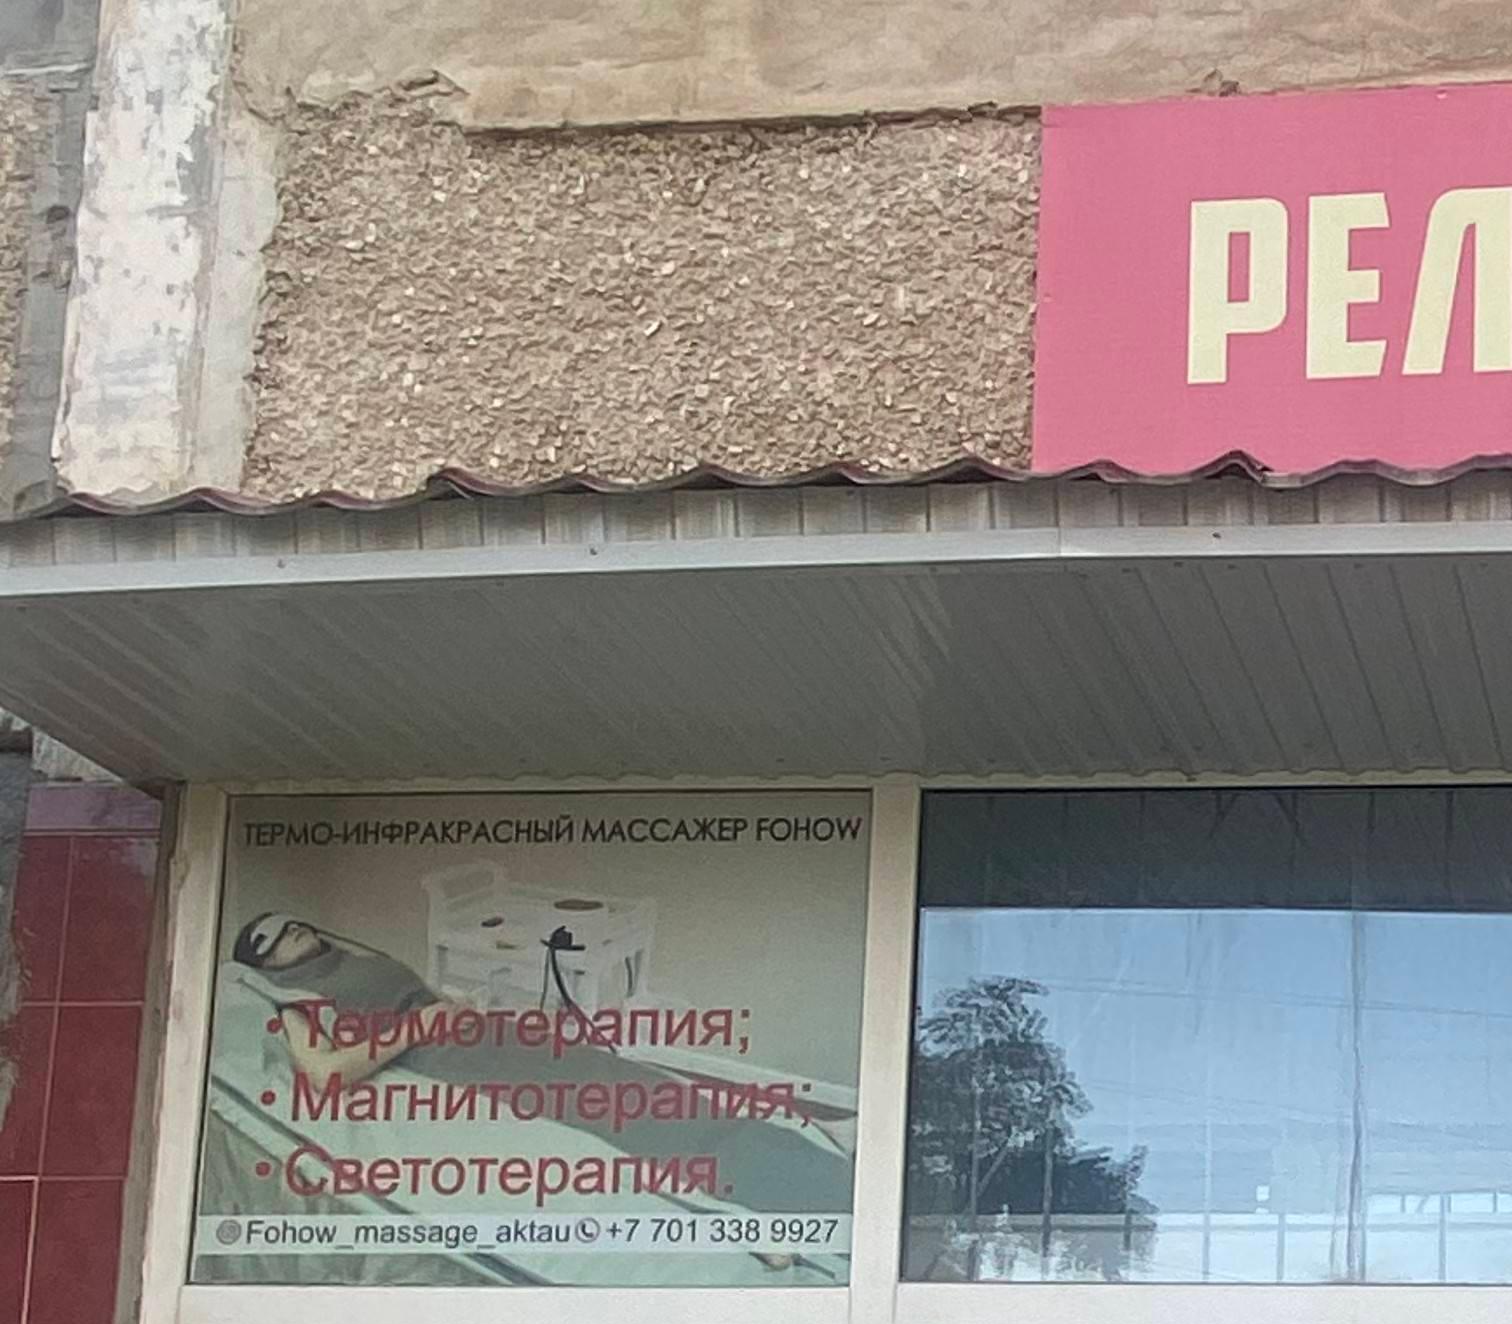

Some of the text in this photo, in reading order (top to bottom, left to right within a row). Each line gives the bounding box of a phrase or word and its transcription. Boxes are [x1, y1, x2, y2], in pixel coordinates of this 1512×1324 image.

[244, 815, 863, 847] ТЕРМО-ИНФРАКРАСНЫЙ МАССАЖЕР FOHOW
[300, 999, 751, 1058] Термотерапия;
[290, 1071, 815, 1132] Магнитотерапия;
[285, 1146, 735, 1206] Светотерапия.
[246, 1217, 838, 1251] Fohow_massage_aktau +7 701 338 9927
